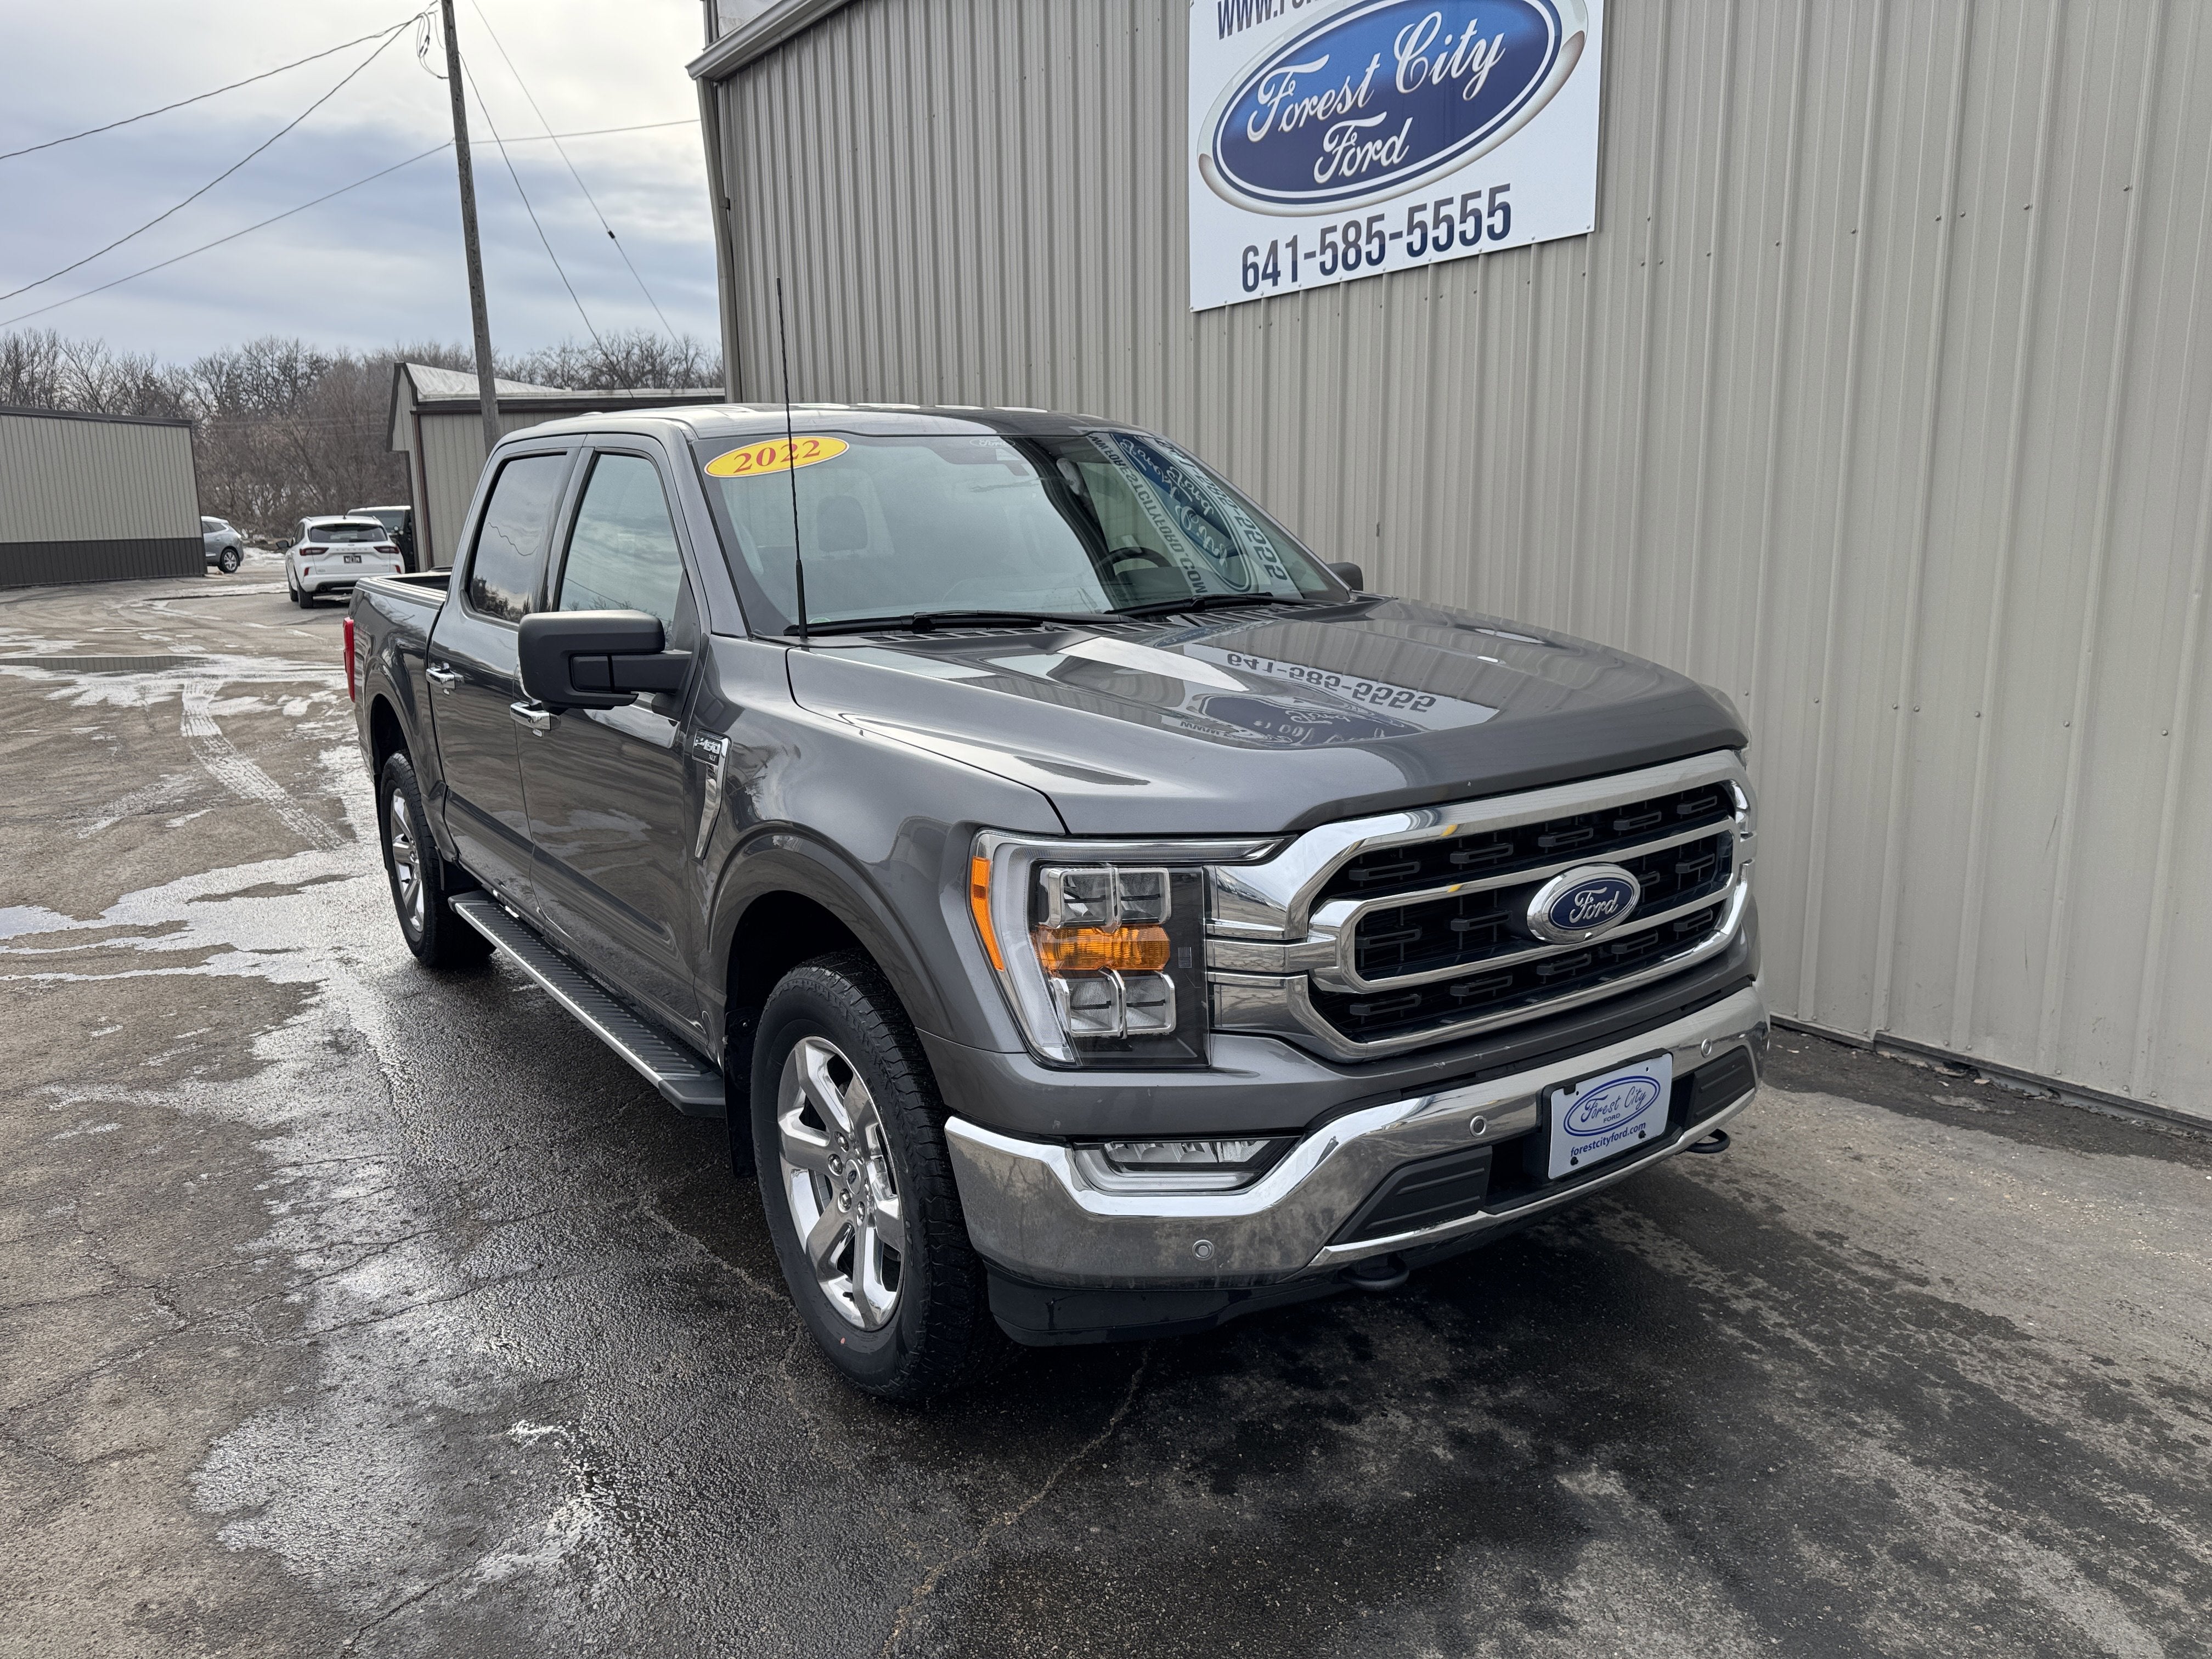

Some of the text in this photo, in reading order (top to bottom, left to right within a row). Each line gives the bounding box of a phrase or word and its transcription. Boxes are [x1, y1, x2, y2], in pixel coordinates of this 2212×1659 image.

[1247, 11, 1506, 142] Forest City
[1314, 111, 1413, 183] Ford
[1242, 183, 1511, 292] 641-585-5555
[733, 439, 821, 473] 2022
[1569, 887, 1620, 923] Ford
[1581, 1086, 1646, 1122] Forest City
[1603, 1113, 1621, 1123] FORD
[1570, 1122, 1646, 1156] forestcityford.com
